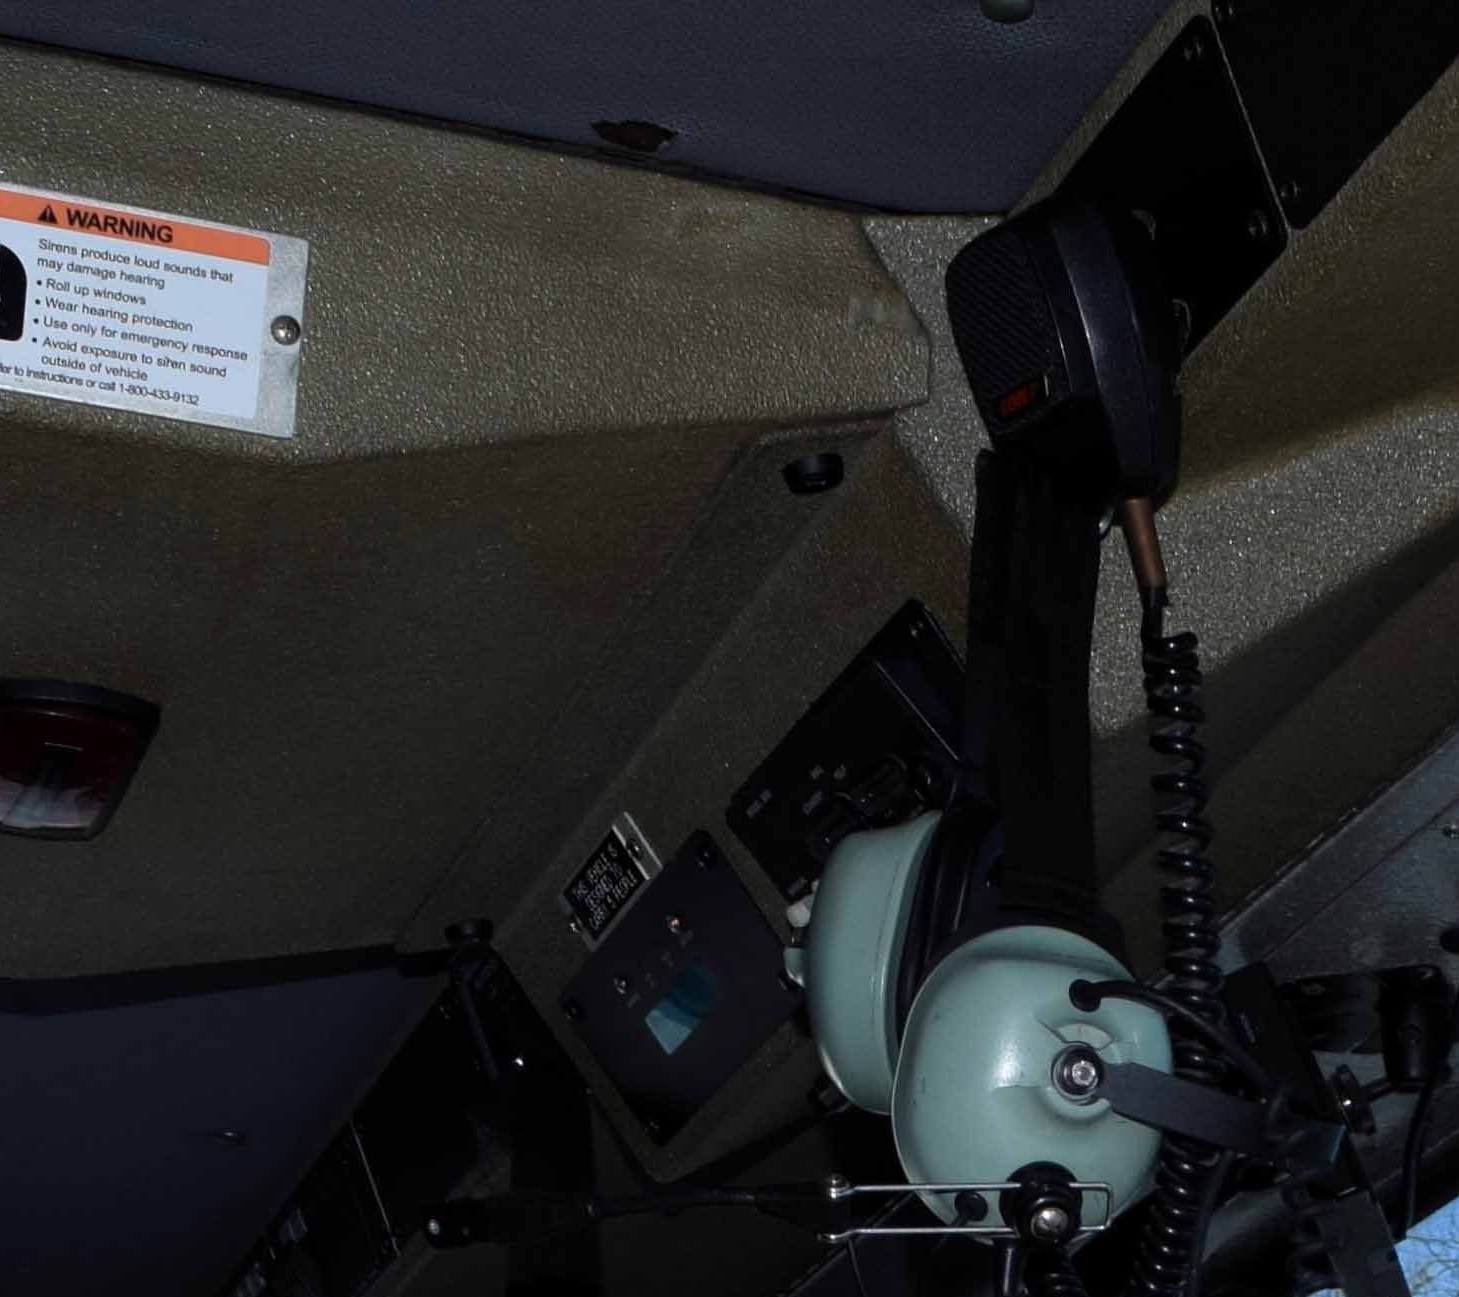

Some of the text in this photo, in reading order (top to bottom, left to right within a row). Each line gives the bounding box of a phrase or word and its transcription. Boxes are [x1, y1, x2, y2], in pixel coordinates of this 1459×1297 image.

[67, 208, 174, 243] WARNING
[37, 257, 165, 289] may damage hearing
[38, 238, 233, 283] Sirens produce loud sounds that
[46, 278, 146, 305] Roll up windows
[46, 297, 193, 332] Wear hearing protection
[43, 316, 248, 361] Use only for emergency response
[41, 354, 148, 382] outside of vehicle
[43, 336, 227, 378] Avoid exposure to siren sound
[14, 365, 24, 376] to
[26, 367, 84, 387] instructions
[86, 378, 96, 388] or
[99, 380, 116, 392] call
[119, 383, 200, 406] 1-800-433-9132
